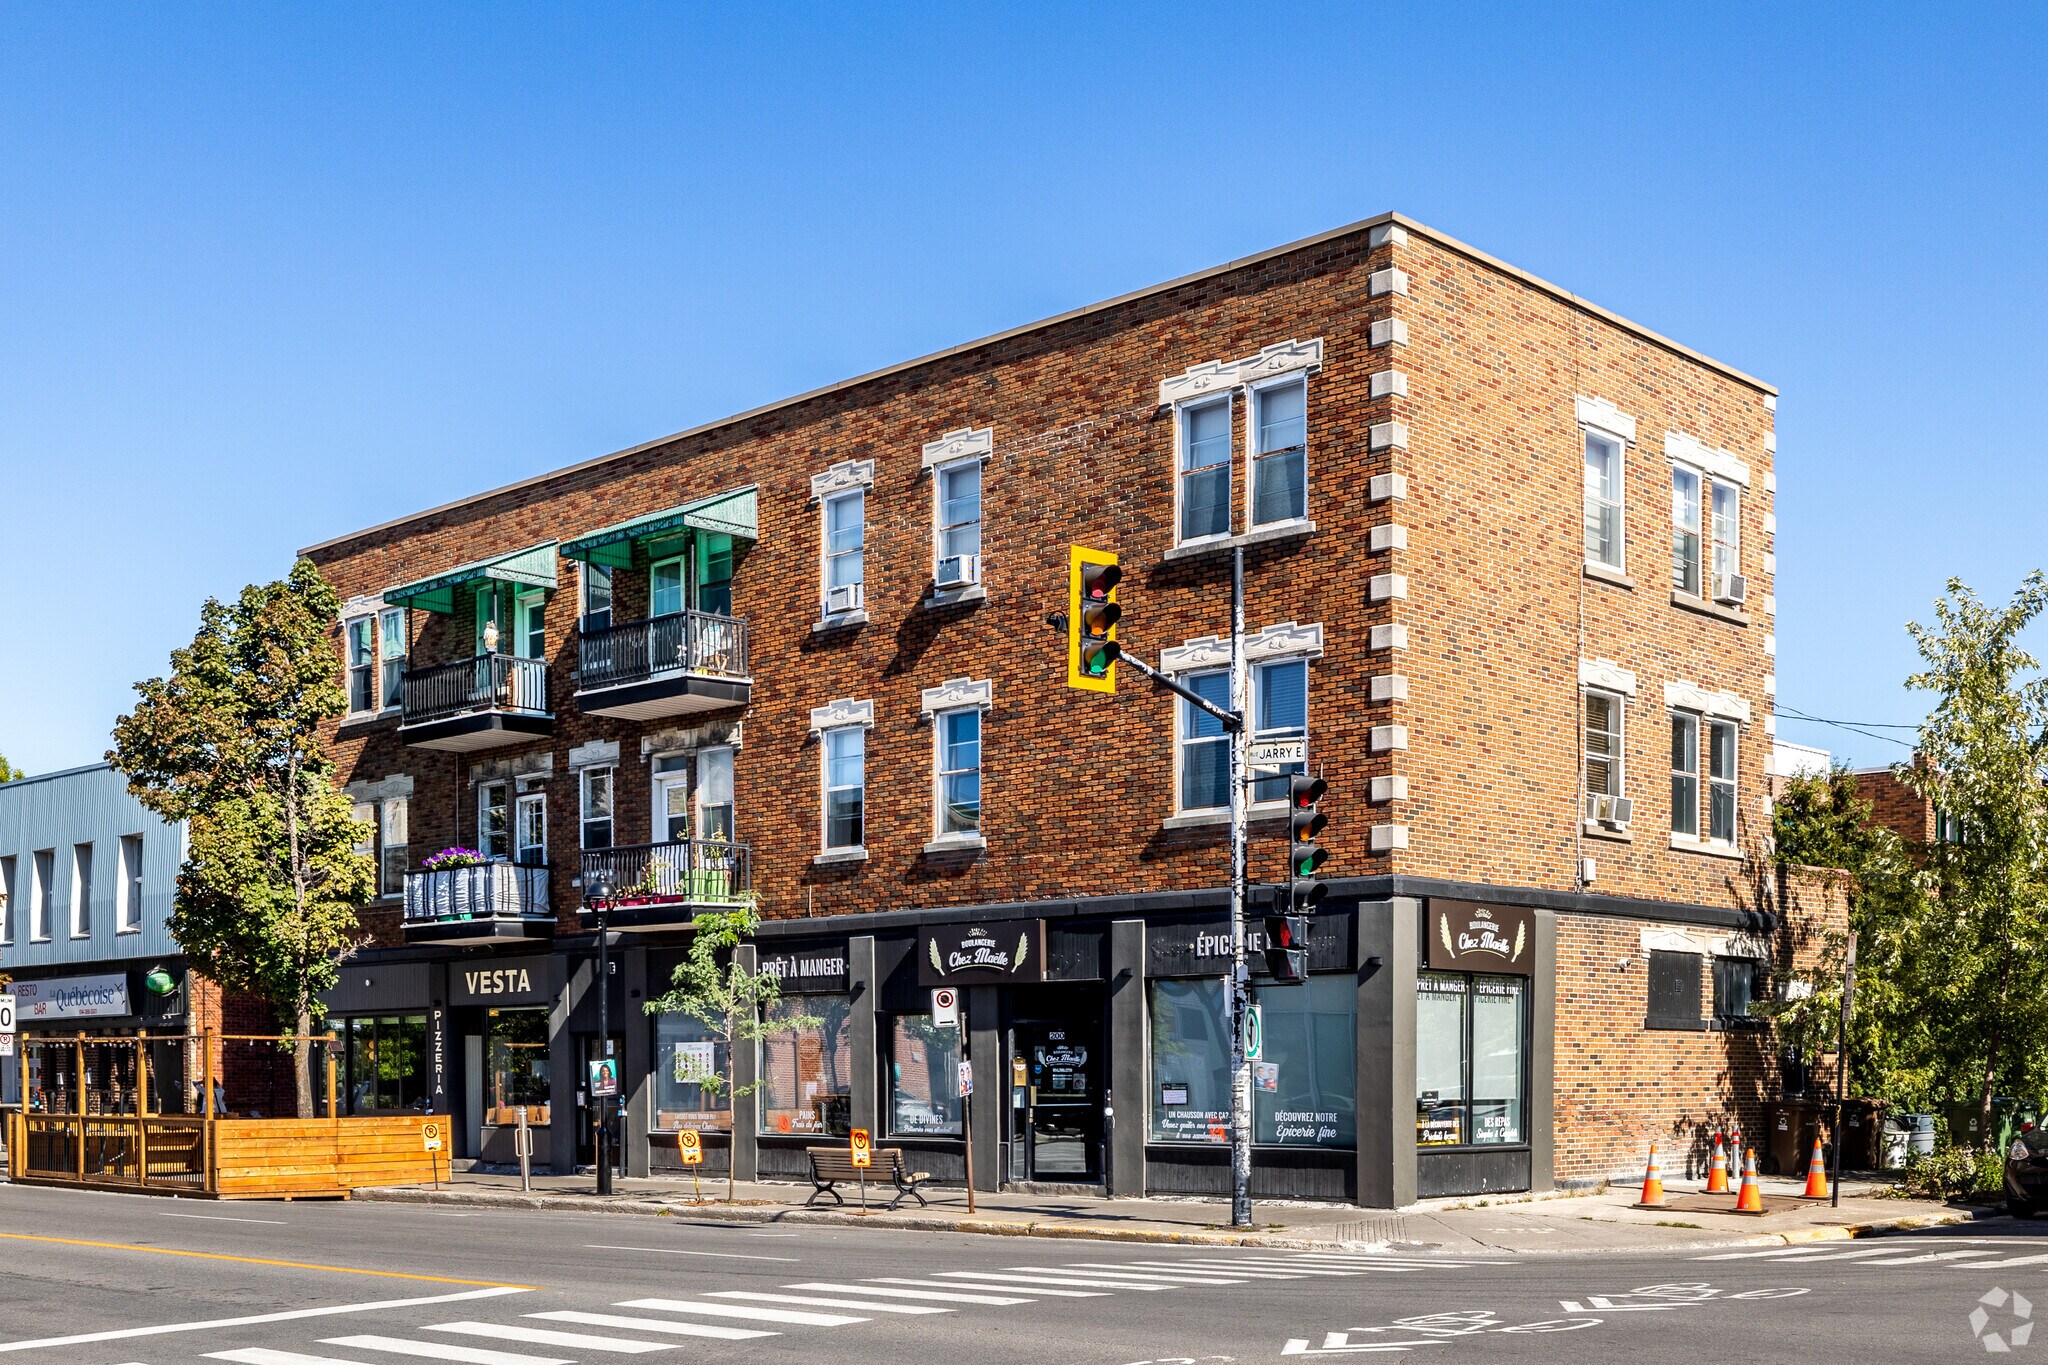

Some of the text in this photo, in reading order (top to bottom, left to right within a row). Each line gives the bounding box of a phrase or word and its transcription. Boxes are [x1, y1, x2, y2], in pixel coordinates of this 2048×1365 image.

[1260, 747, 1292, 760] JARRY
[1296, 747, 1304, 758] E.
[1469, 921, 1500, 932] BOULANGERIE
[961, 938, 996, 948] BOULANGERIE
[1196, 931, 1262, 956] ÉPICIE
[1458, 932, 1510, 954] Chez Maëlle
[948, 948, 1008, 968] Chez Maëlle
[762, 956, 844, 978] PRÊT À MANGER
[465, 969, 532, 994] VESTA
[1416, 976, 1432, 990] PRÊT
[1440, 980, 1466, 992] MANGER
[1479, 978, 1520, 995] ÉPICERIE FINE
[18, 984, 38, 996] RESTO
[56, 985, 114, 1012] Québécoise
[34, 1003, 46, 1014] BAR
[1049, 1032, 1065, 1040] 200
[434, 1010, 443, 1094] PIZZERIA
[800, 1110, 816, 1120] PAINS
[910, 1114, 943, 1124] DE DIVINES
[1168, 1110, 1176, 1118] UN
[1177, 1111, 1204, 1119] CHAUSSON
[1218, 1112, 1228, 1120] ÇA?
[1274, 1110, 1338, 1122] DÉCOUVREZ NOTRE
[1162, 1119, 1178, 1128] Venez
[1484, 1116, 1511, 1128] DES REPAS
[1276, 1122, 1337, 1143] Épicerie fine
